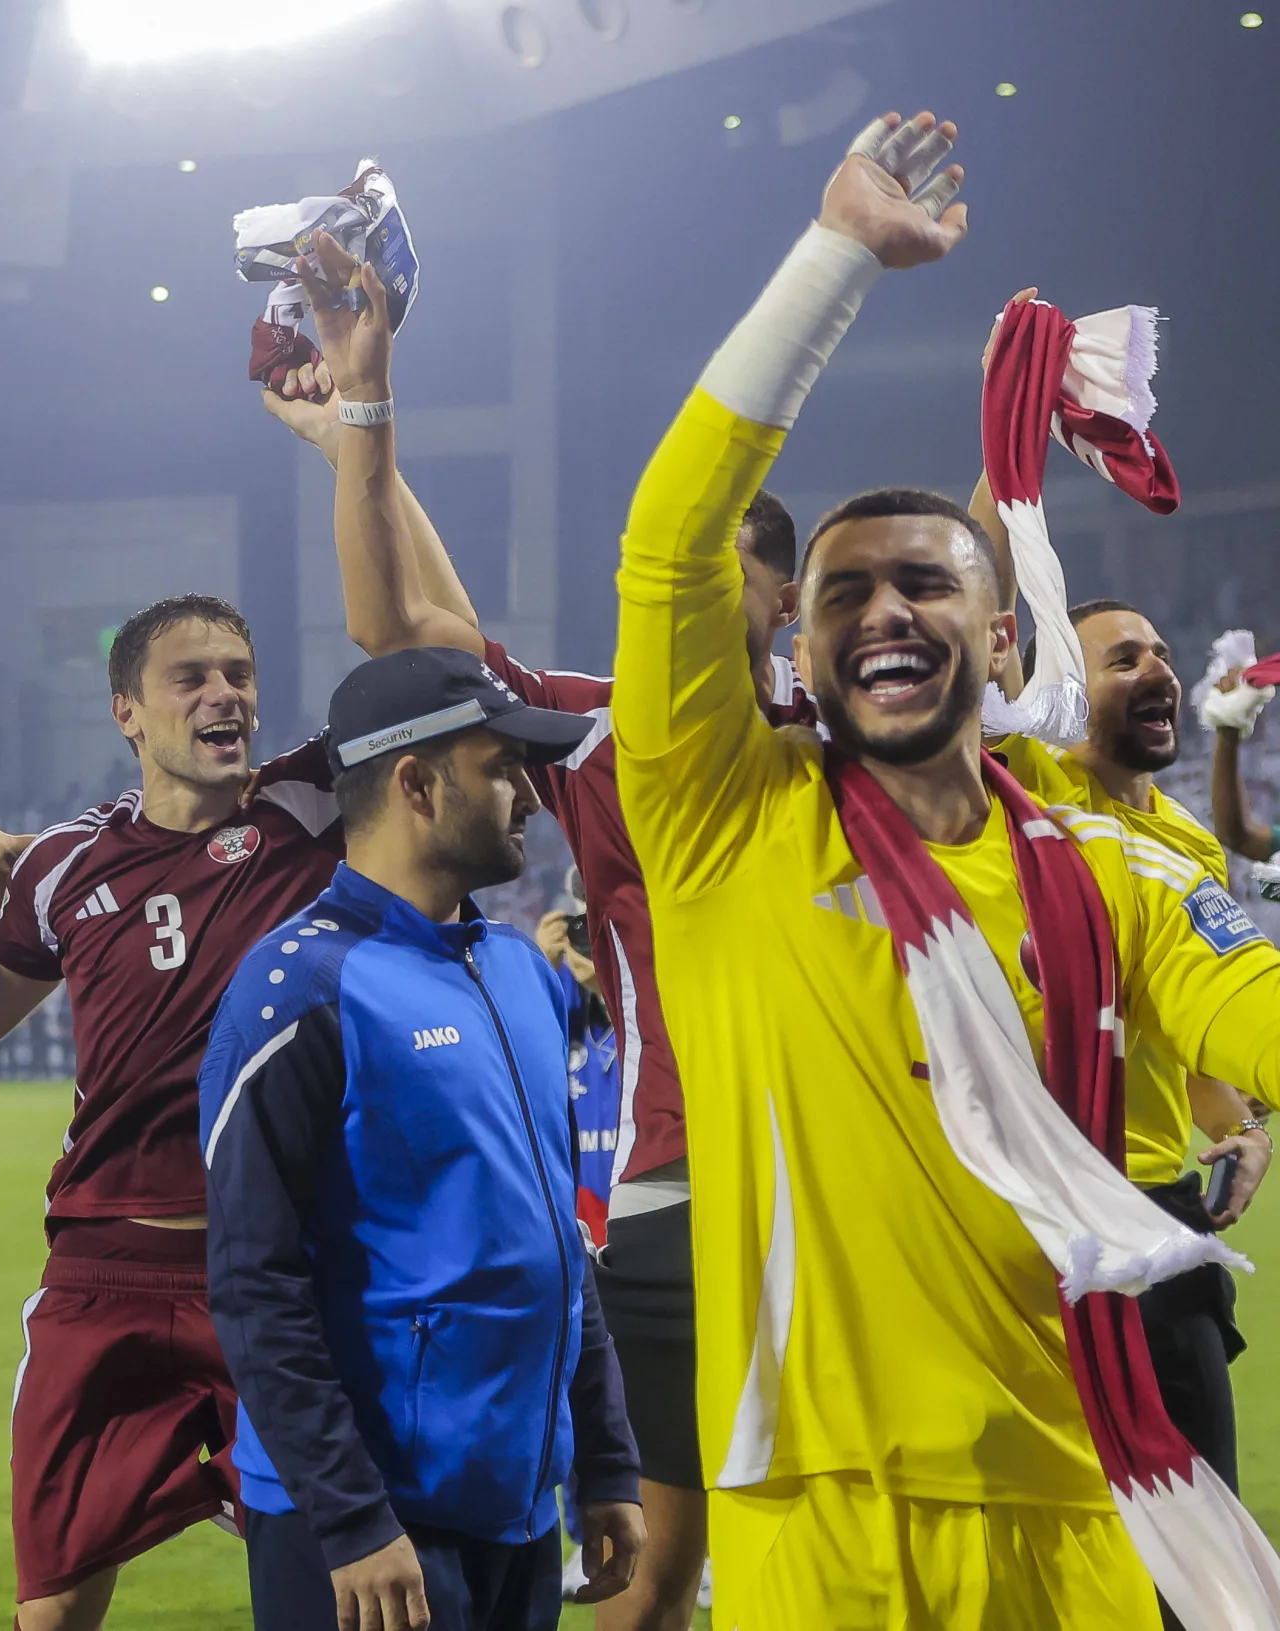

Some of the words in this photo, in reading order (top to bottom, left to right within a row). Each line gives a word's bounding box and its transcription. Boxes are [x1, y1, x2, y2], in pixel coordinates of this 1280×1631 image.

[368, 728, 413, 751] Security
[145, 893, 186, 971] 3
[413, 1026, 460, 1050] JAKO
